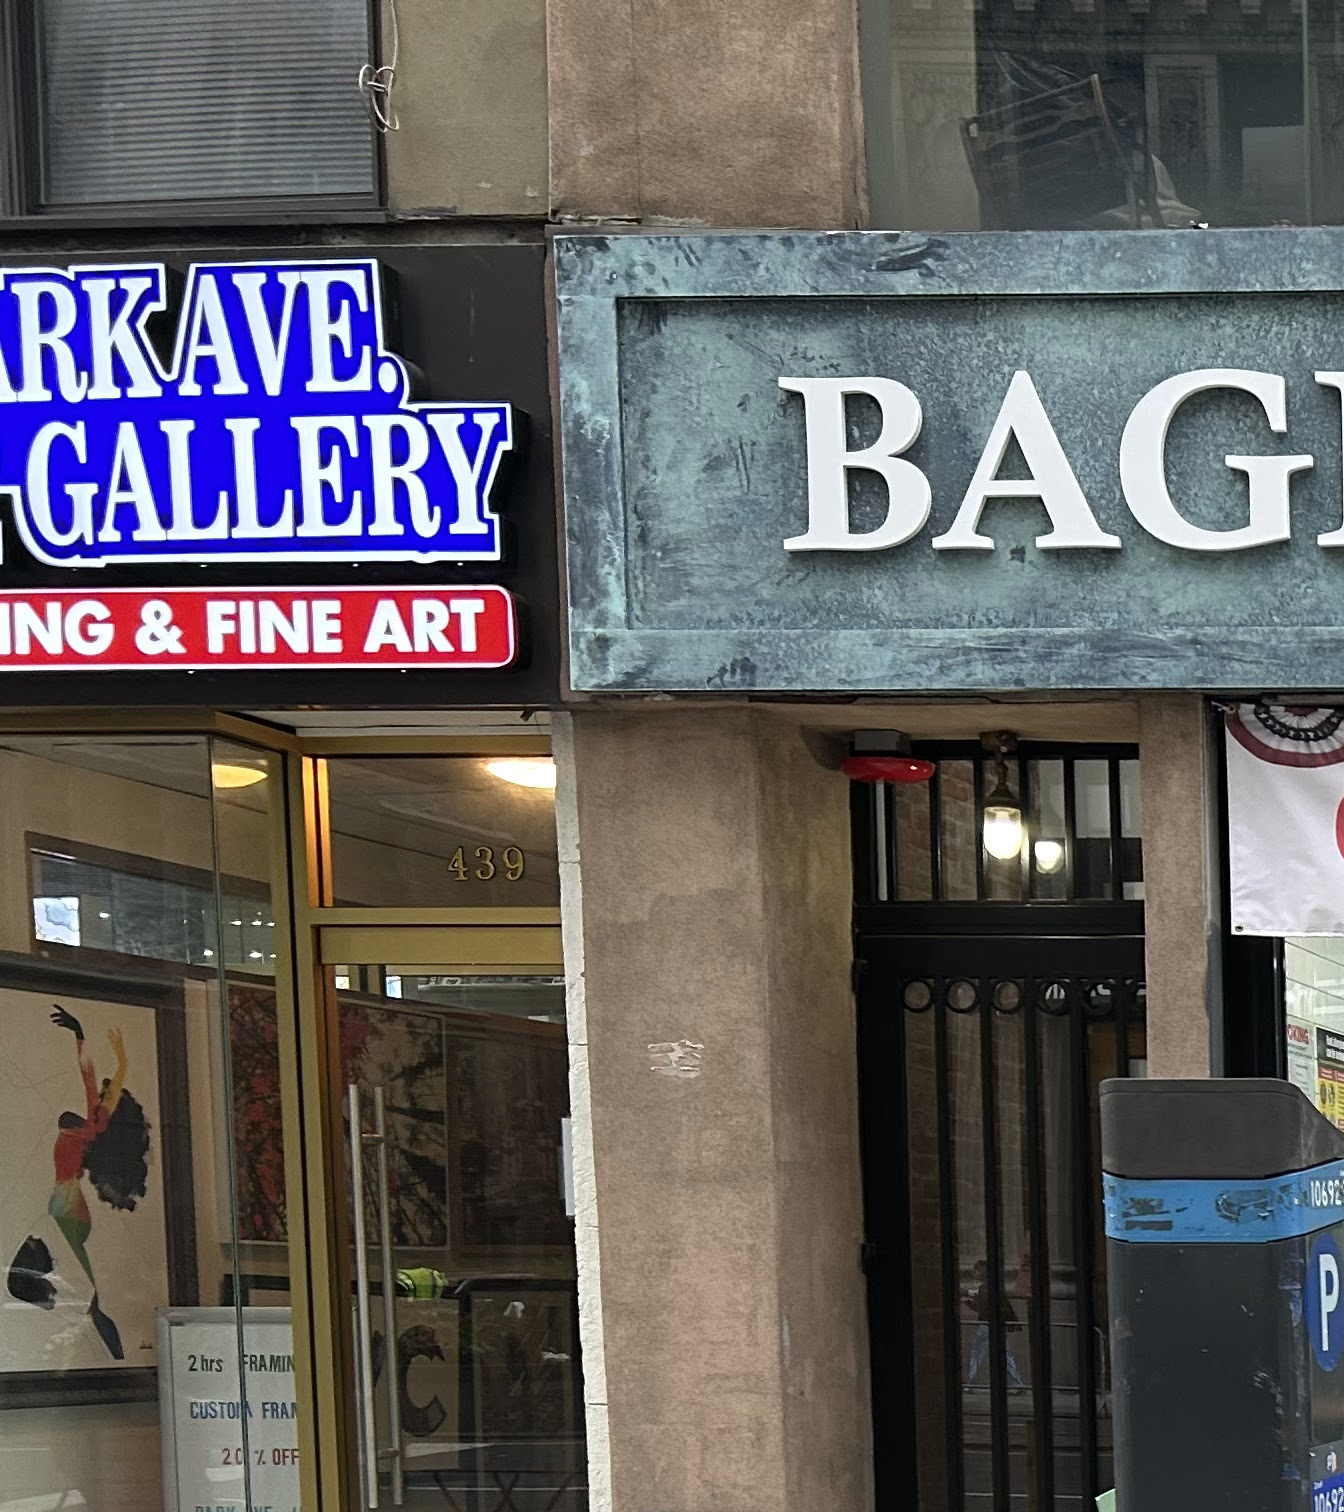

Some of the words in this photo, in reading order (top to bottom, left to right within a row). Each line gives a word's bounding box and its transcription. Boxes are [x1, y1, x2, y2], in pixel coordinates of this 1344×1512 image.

[178, 270, 398, 396] AVE.
[25, 412, 499, 547] GALLERY
[135, 599, 187, 655] &
[207, 599, 342, 653] FINE
[364, 599, 485, 653] ART
[447, 846, 524, 881] 439
[1319, 1253, 1341, 1352] P
[272, 1448, 300, 1466] OFF
